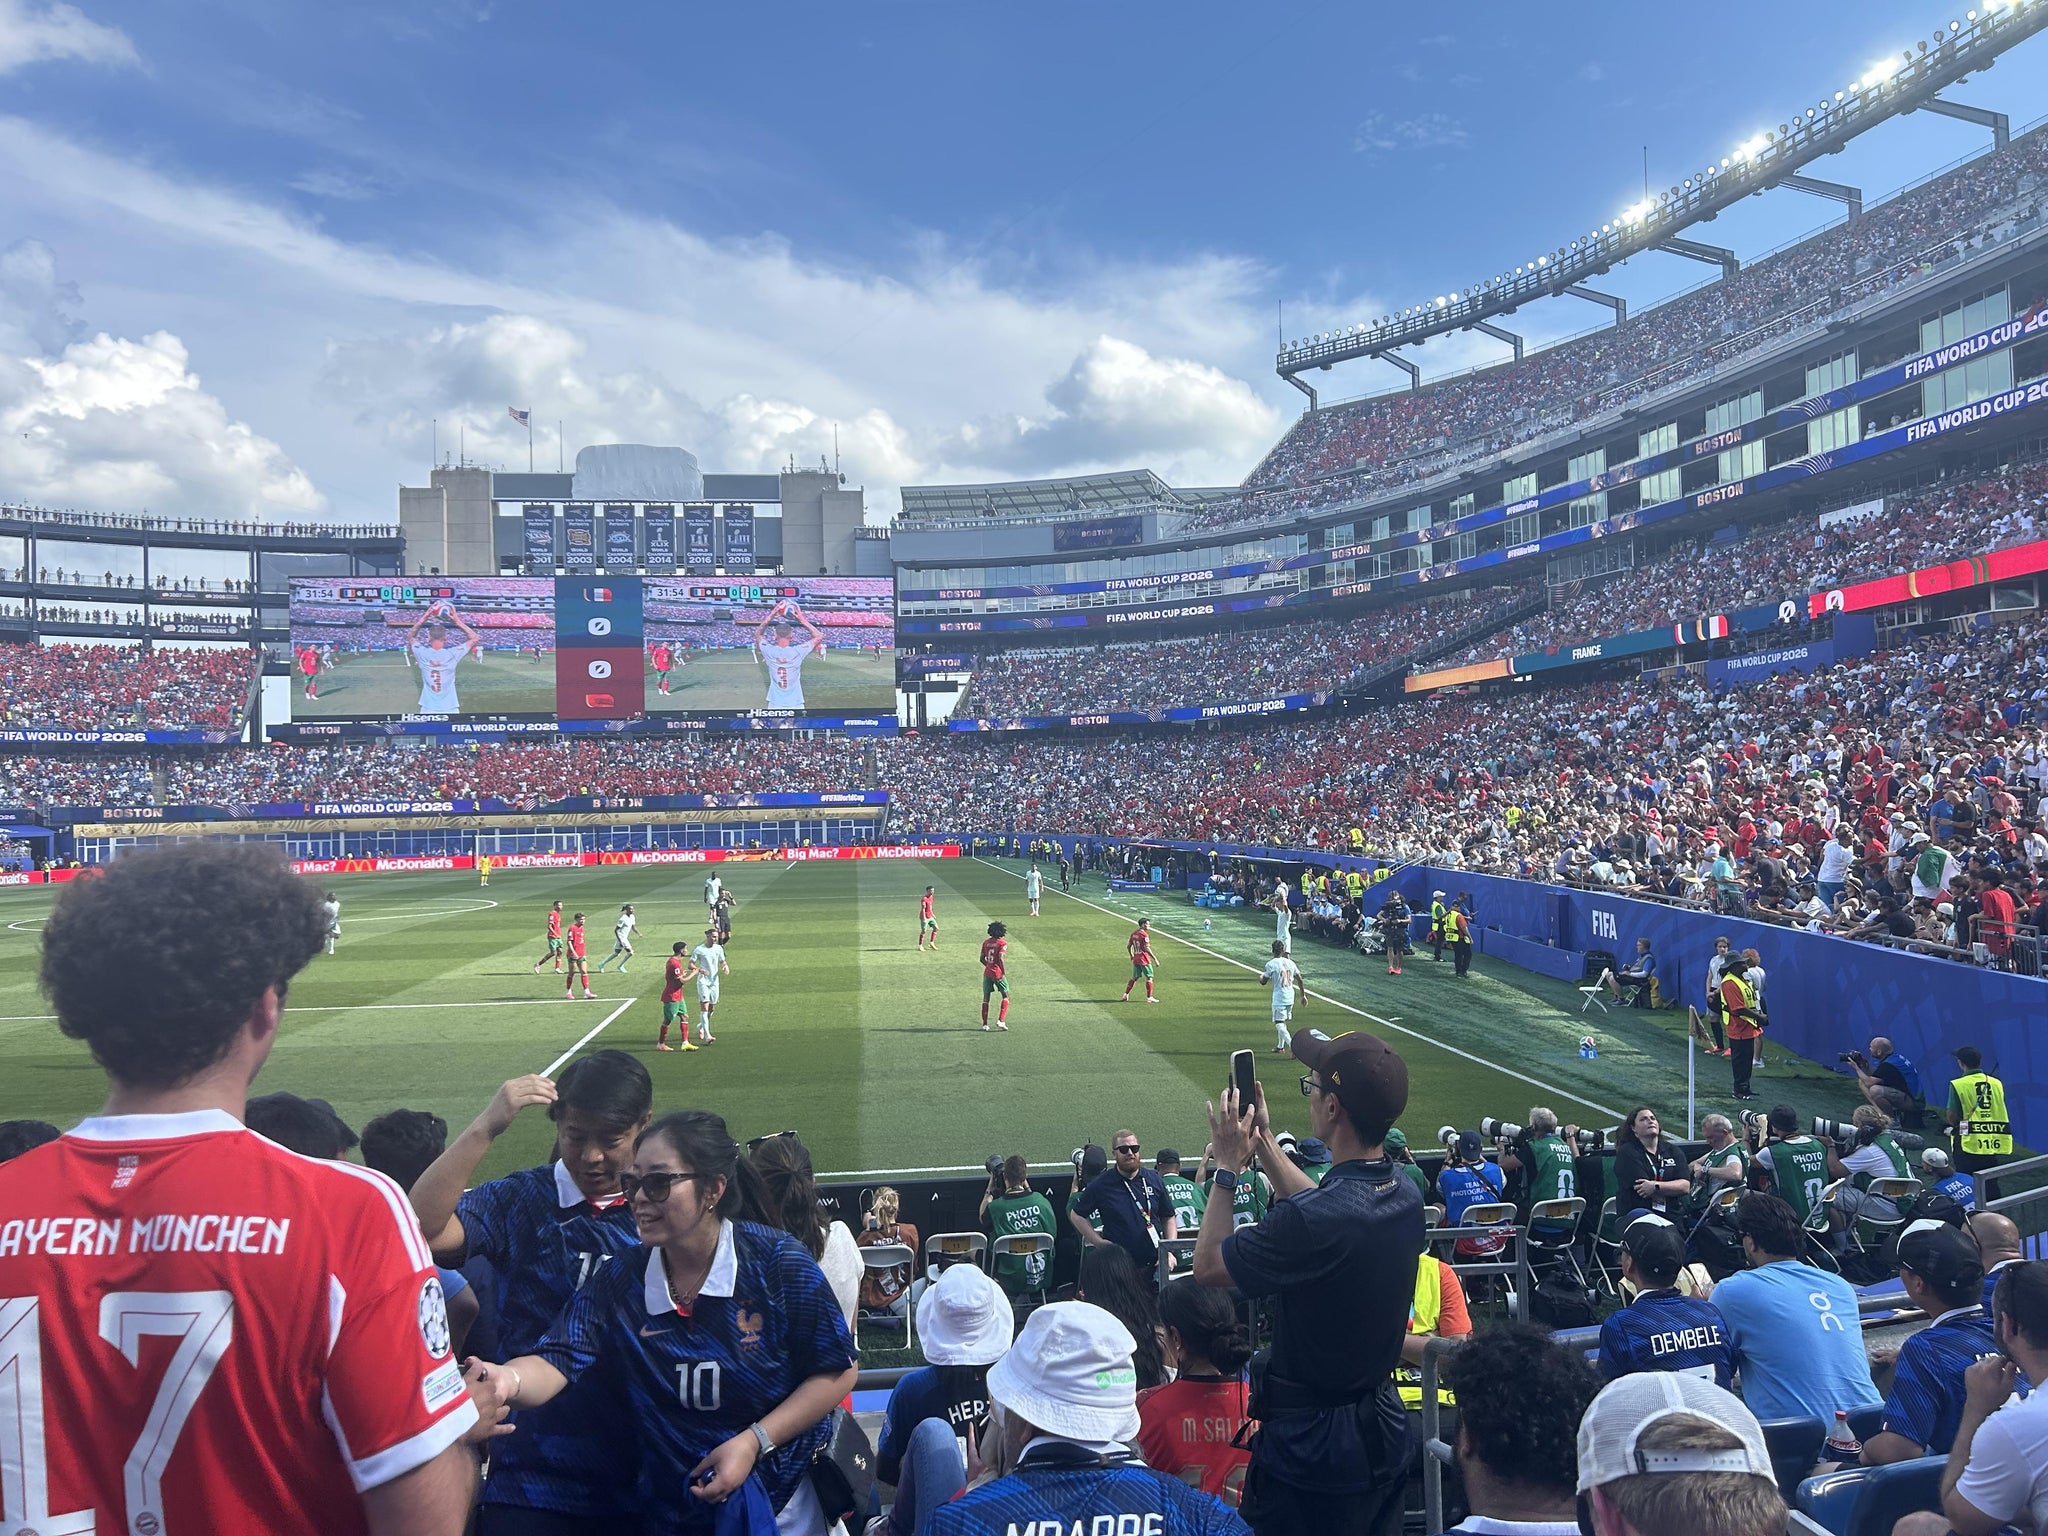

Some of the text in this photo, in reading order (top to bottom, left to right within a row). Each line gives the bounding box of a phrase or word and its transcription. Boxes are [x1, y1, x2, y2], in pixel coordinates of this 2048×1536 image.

[1905, 356, 1935, 379] FIFA
[1936, 335, 1989, 366] WORLD
[1991, 321, 2022, 345] CUP
[1907, 420, 1937, 442] FIFA
[1938, 402, 1992, 431] WORLD
[1993, 390, 2025, 412] CUP
[1695, 428, 1742, 454] BOSTON
[1697, 482, 1744, 507] BOSTON
[1081, 528, 1113, 538] BOSTON
[1331, 545, 1370, 559] BOSTON
[1106, 571, 1213, 590] FIFA WORLD CUP 2026
[305, 589, 333, 598] 31:54
[657, 588, 684, 597] 31:54
[713, 588, 727, 596] FRA
[939, 589, 981, 599] BOSTON
[1332, 582, 1371, 597] BOSTON
[1106, 605, 1214, 623] FIFA WORLD CUP 2026
[177, 624, 199, 633] 2021
[939, 622, 981, 631] BOSTON
[1572, 644, 1602, 660] FRANCE
[1727, 647, 1808, 670] FIFA WORLD CUP 2026
[922, 659, 961, 668] BOSTON
[750, 708, 795, 717] Hisense
[1202, 699, 1286, 717] FIFA WORLD CUP 2026
[401, 713, 450, 722] Hisense
[1070, 714, 1110, 726] BOSTON
[299, 726, 341, 735] BOSTON
[451, 723, 559, 732] FIFA WORLD CUP 2026
[667, 720, 706, 729] BOSTON
[27, 731, 74, 742] WORLD
[74, 732, 101, 742] CUP
[101, 732, 146, 742] 2026
[103, 808, 164, 819] BOSTON
[314, 801, 454, 814] FIFA WORLD CUP 2026
[631, 850, 706, 864] McDonald's
[787, 848, 840, 861] Big Mac?
[877, 846, 944, 859] McDelivery
[303, 861, 337, 872] Mac?
[376, 857, 454, 871] McDonald's
[506, 854, 580, 868] McDelivery
[1592, 909, 1618, 941] FIFA
[1792, 1151, 1823, 1164] PHOTO
[1800, 1162, 1821, 1173] 1707
[1945, 1180, 1964, 1193] FIFA
[1006, 1205, 1040, 1222] PHOTO
[0, 1217, 121, 1257] AYERN
[1650, 1324, 1722, 1357] DEMBELE
[675, 1361, 722, 1411] 10
[0, 1290, 235, 1536] 17
[948, 1400, 991, 1425] HER
